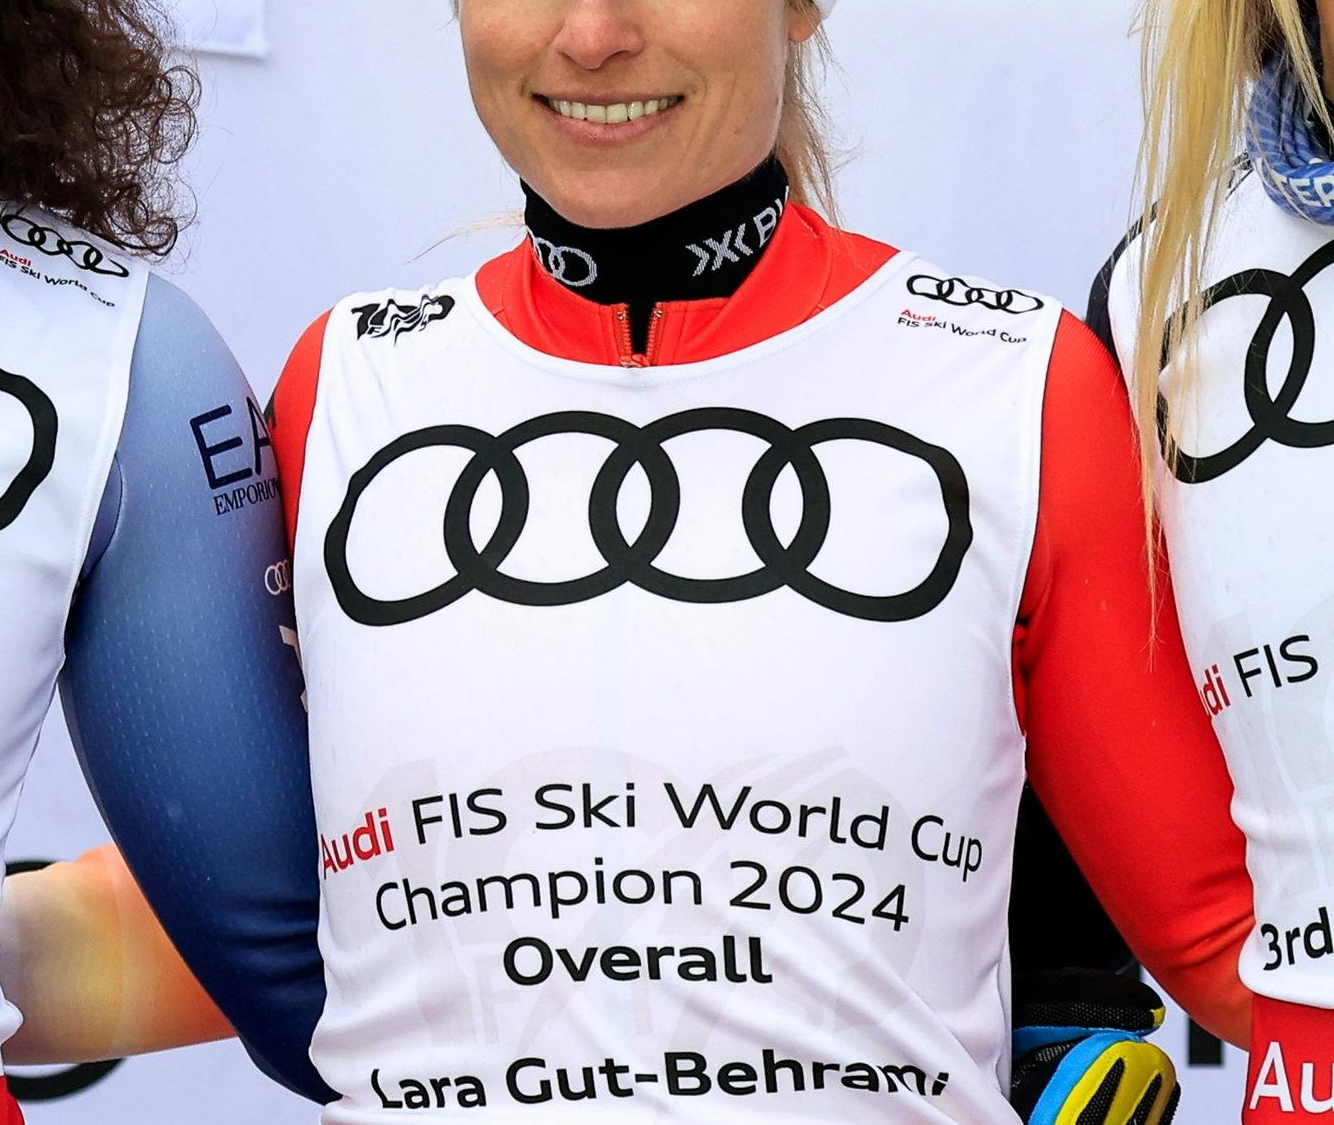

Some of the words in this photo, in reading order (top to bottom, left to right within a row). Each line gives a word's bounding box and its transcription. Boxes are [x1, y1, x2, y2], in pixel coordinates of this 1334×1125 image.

[0, 249, 32, 267] Audi
[20, 265, 42, 280] Ski
[90, 291, 116, 308] Cup
[897, 317, 920, 327] FIS
[951, 323, 997, 337] World
[1000, 331, 1028, 344] Cup
[901, 308, 936, 321] Audi
[1200, 663, 1231, 716] di
[1233, 633, 1319, 698] FIS
[320, 807, 395, 880] Audi
[411, 788, 508, 845] FIS
[534, 782, 637, 831] Ski
[662, 781, 891, 852] World
[910, 814, 984, 883] Cup
[375, 857, 703, 932] Champion
[729, 860, 910, 933] 2024
[503, 935, 774, 987] Overall
[1260, 906, 1334, 972] 3rd
[370, 1067, 488, 1111] Lara
